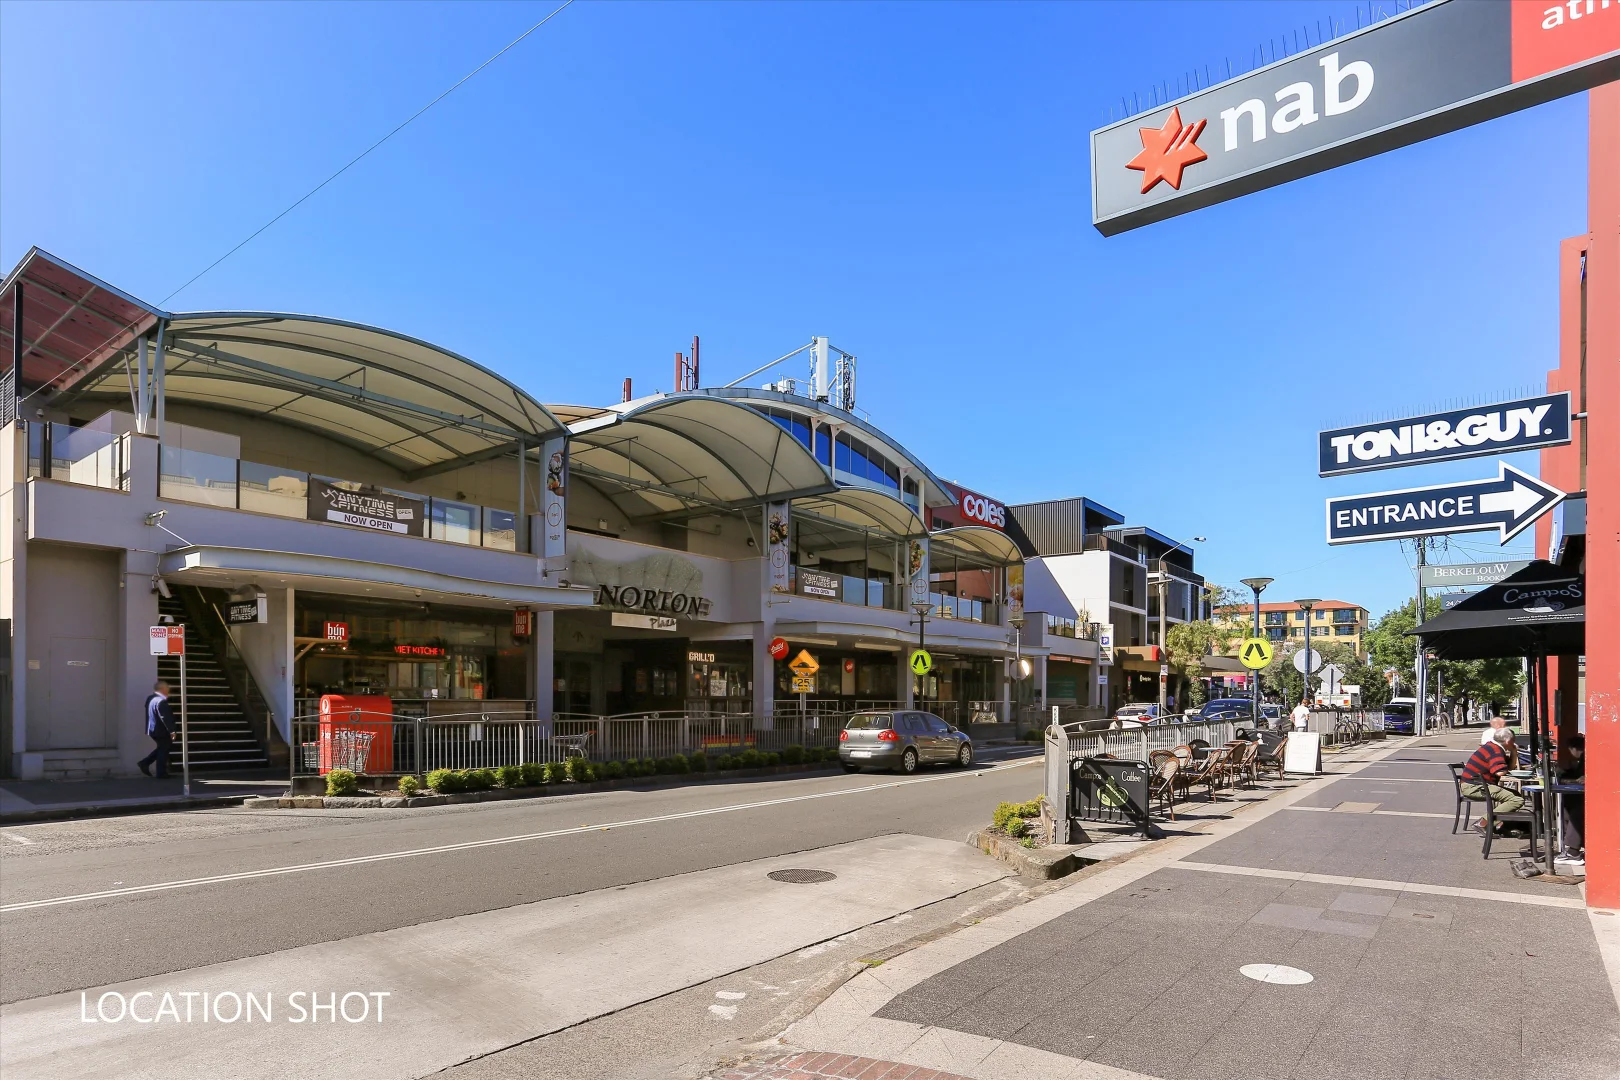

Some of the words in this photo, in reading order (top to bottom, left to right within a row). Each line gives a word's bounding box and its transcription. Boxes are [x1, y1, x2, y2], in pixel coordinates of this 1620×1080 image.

[1220, 52, 1374, 152] nab
[337, 492, 394, 510] ANYTIME
[338, 500, 394, 519] FITNESS
[963, 494, 1006, 528] coles
[1336, 495, 1474, 528] ENTRANCE
[344, 514, 368, 525] NOW
[369, 519, 393, 530] OPEN
[1433, 563, 1509, 578] BERKELOUW
[1477, 575, 1506, 583] BOOKS
[597, 584, 704, 617] NORTON
[327, 622, 345, 636] bún
[649, 618, 676, 630] Plaza
[688, 651, 715, 662] GRILL'D
[797, 678, 810, 688] 25
